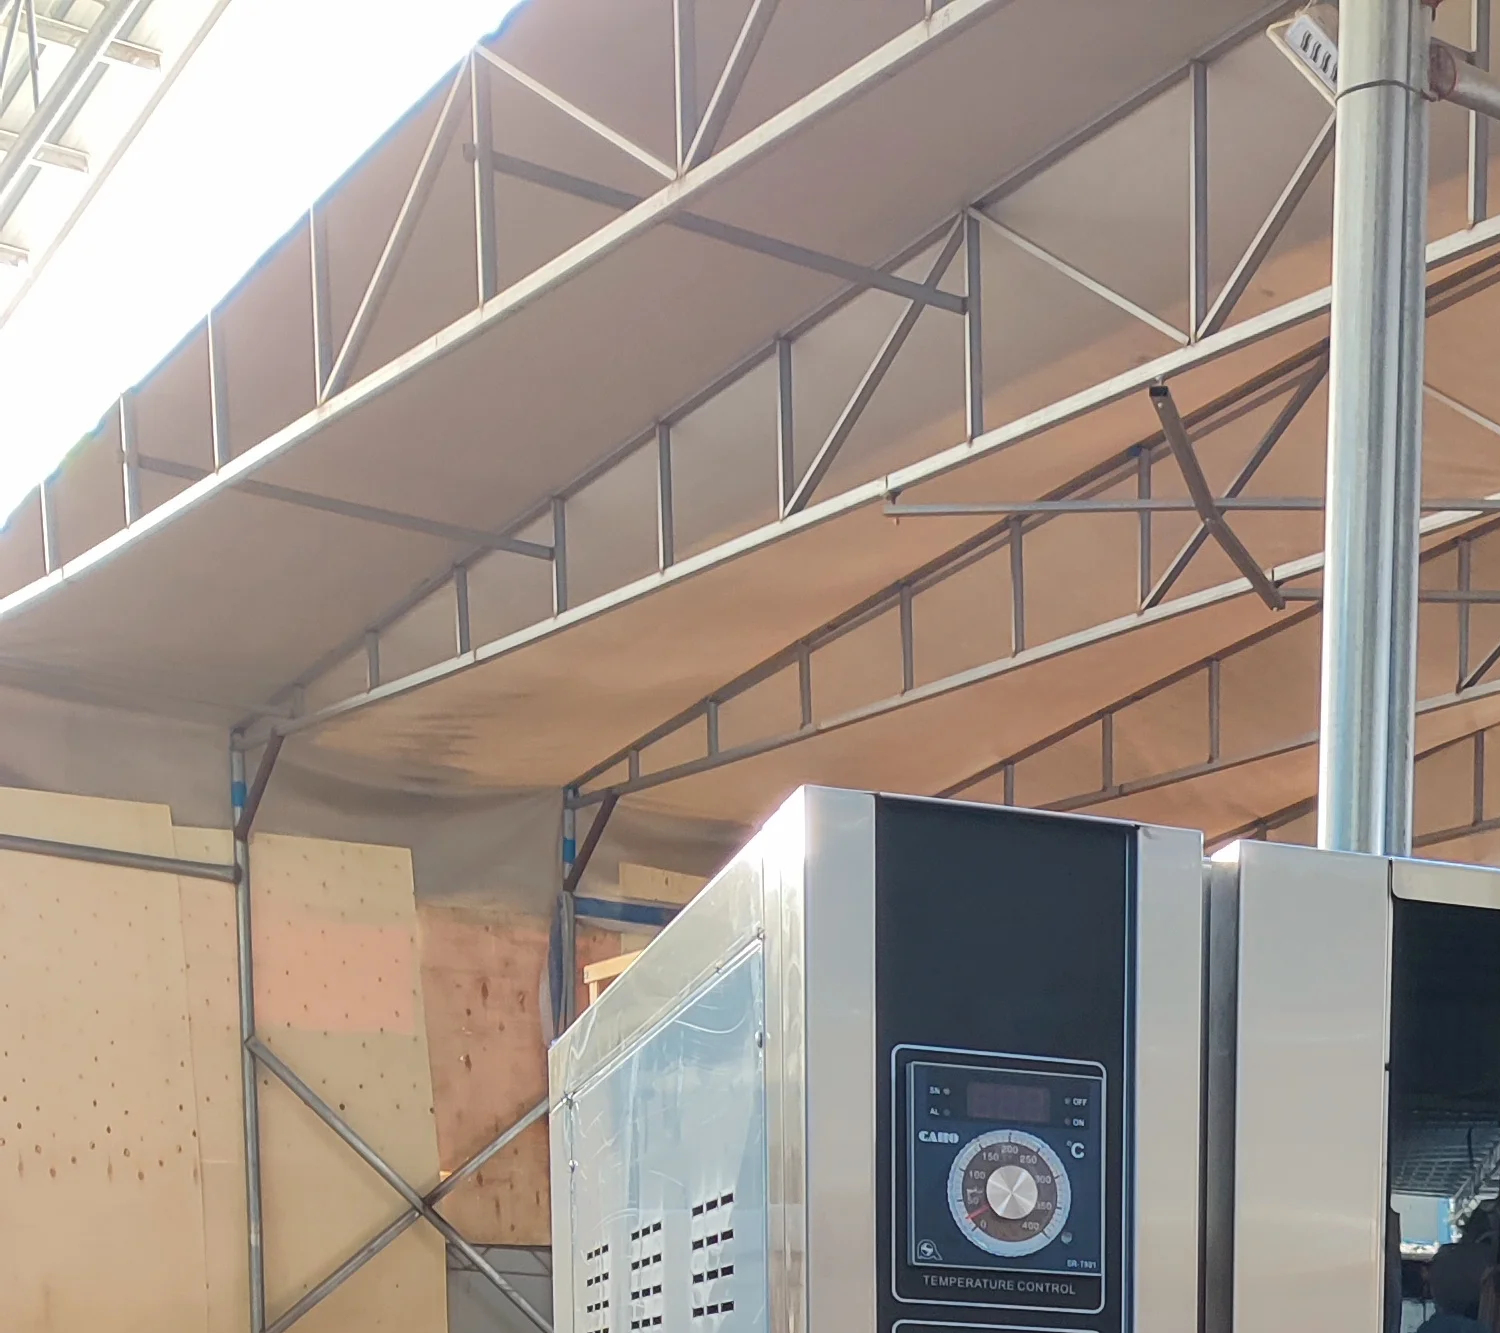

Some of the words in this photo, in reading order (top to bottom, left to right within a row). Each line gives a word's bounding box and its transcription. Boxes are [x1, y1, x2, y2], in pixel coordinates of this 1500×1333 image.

[1072, 1098, 1088, 1106] OFF
[930, 1108, 940, 1116] AL
[1072, 1118, 1084, 1126] ON
[1001, 1145, 1018, 1154] 200
[982, 1152, 1000, 1161] 150
[1020, 1155, 1038, 1164] 250
[969, 1170, 986, 1180] 100
[980, 1220, 986, 1229] 0
[1022, 1221, 1040, 1230] 400
[923, 1275, 1014, 1291] TEMPERATURE
[1017, 1280, 1076, 1295] CONTROL
